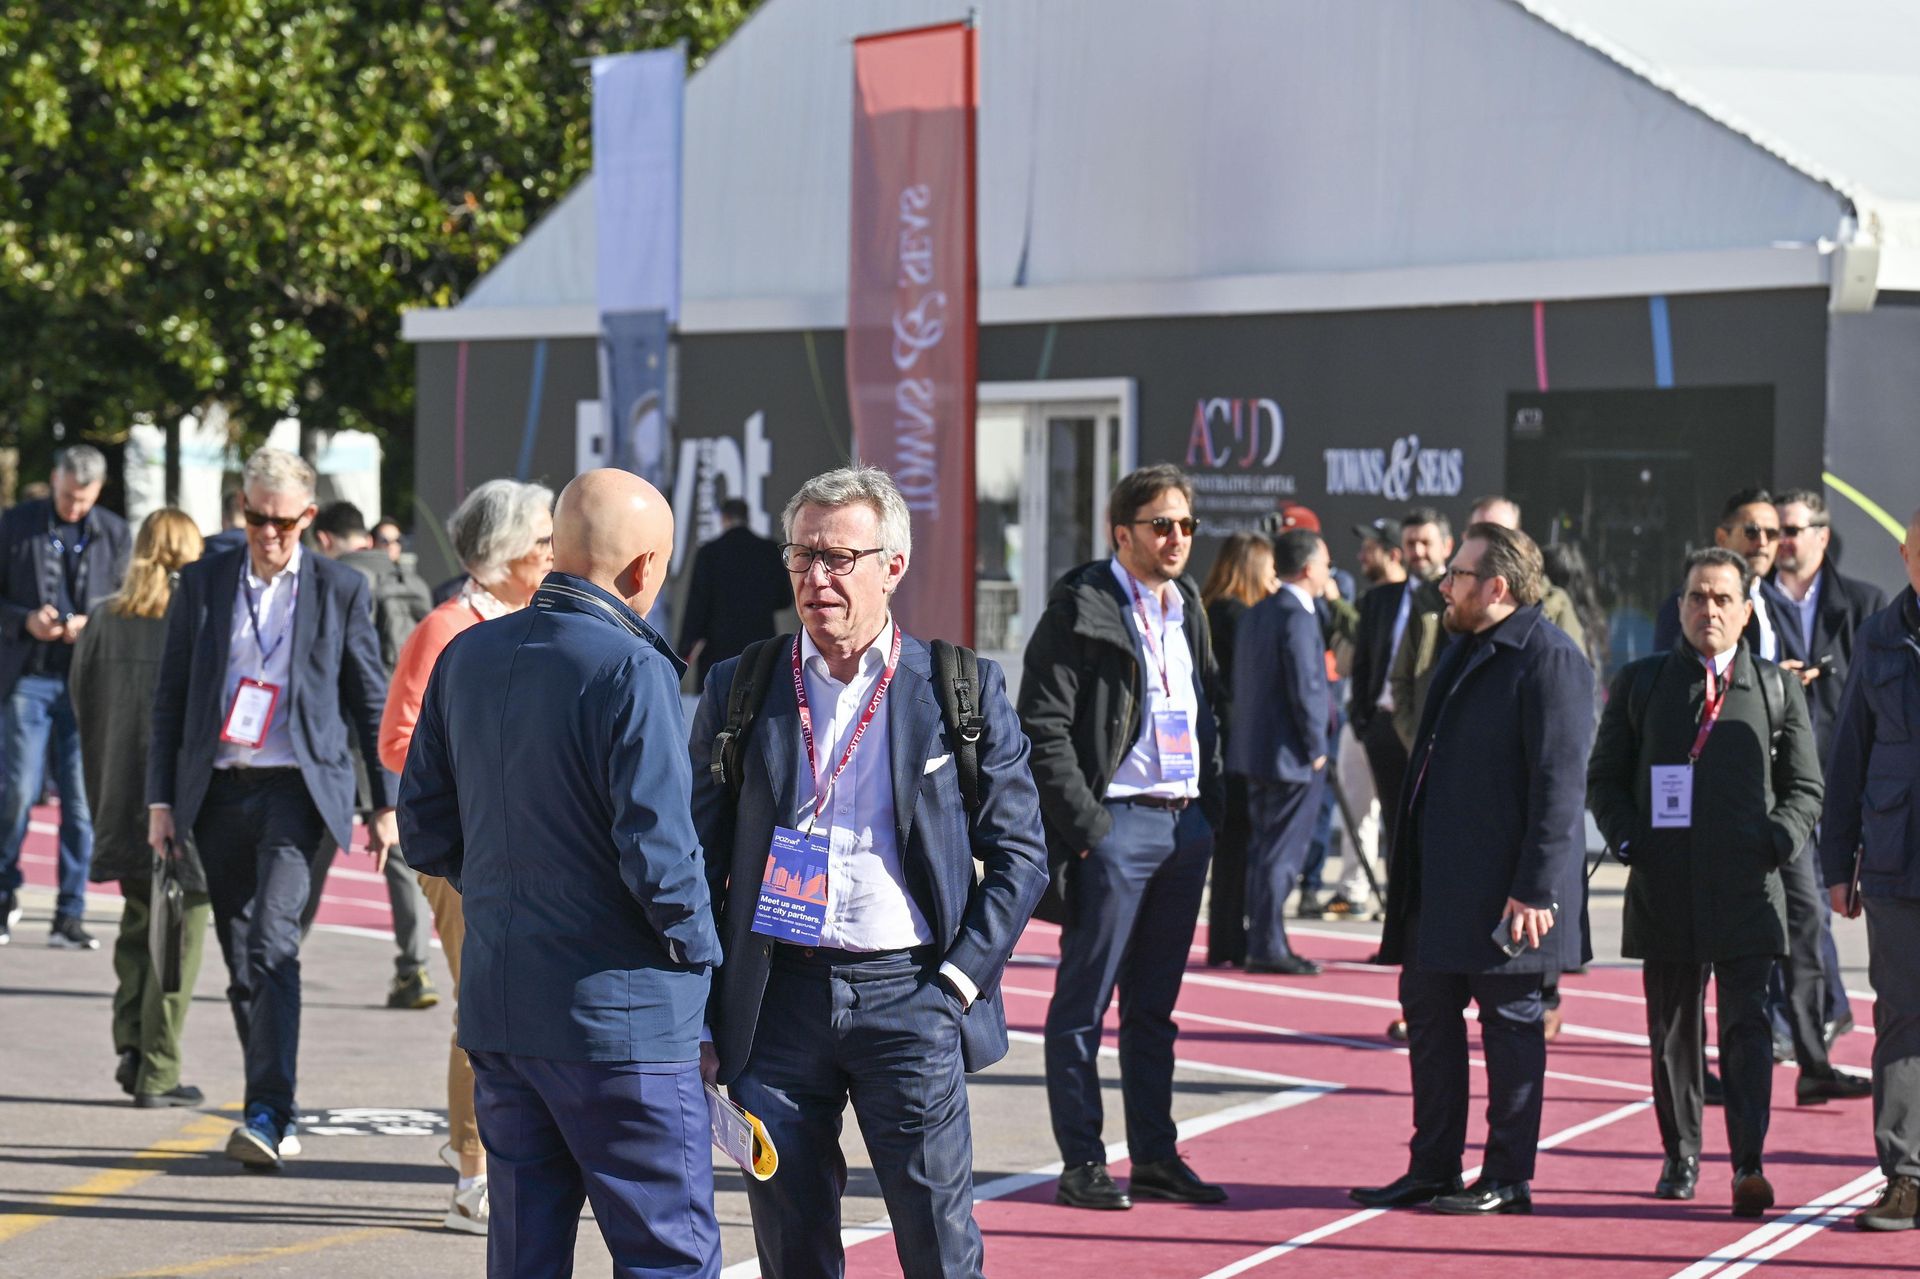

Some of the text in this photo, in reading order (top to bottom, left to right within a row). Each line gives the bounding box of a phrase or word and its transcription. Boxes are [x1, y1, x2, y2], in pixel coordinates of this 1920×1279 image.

[1184, 397, 1284, 468] ACUD
[1323, 434, 1464, 500] TOWNS & SEAS
[793, 667, 806, 704] CATELLA
[800, 712, 813, 752] CATELLA
[846, 721, 869, 757] CATELLA
[868, 677, 892, 713] CATELLA
[889, 637, 902, 670] CATELLA
[758, 904, 821, 924] our city partners.
[760, 894, 780, 906] Meet
[791, 903, 806, 912] and
